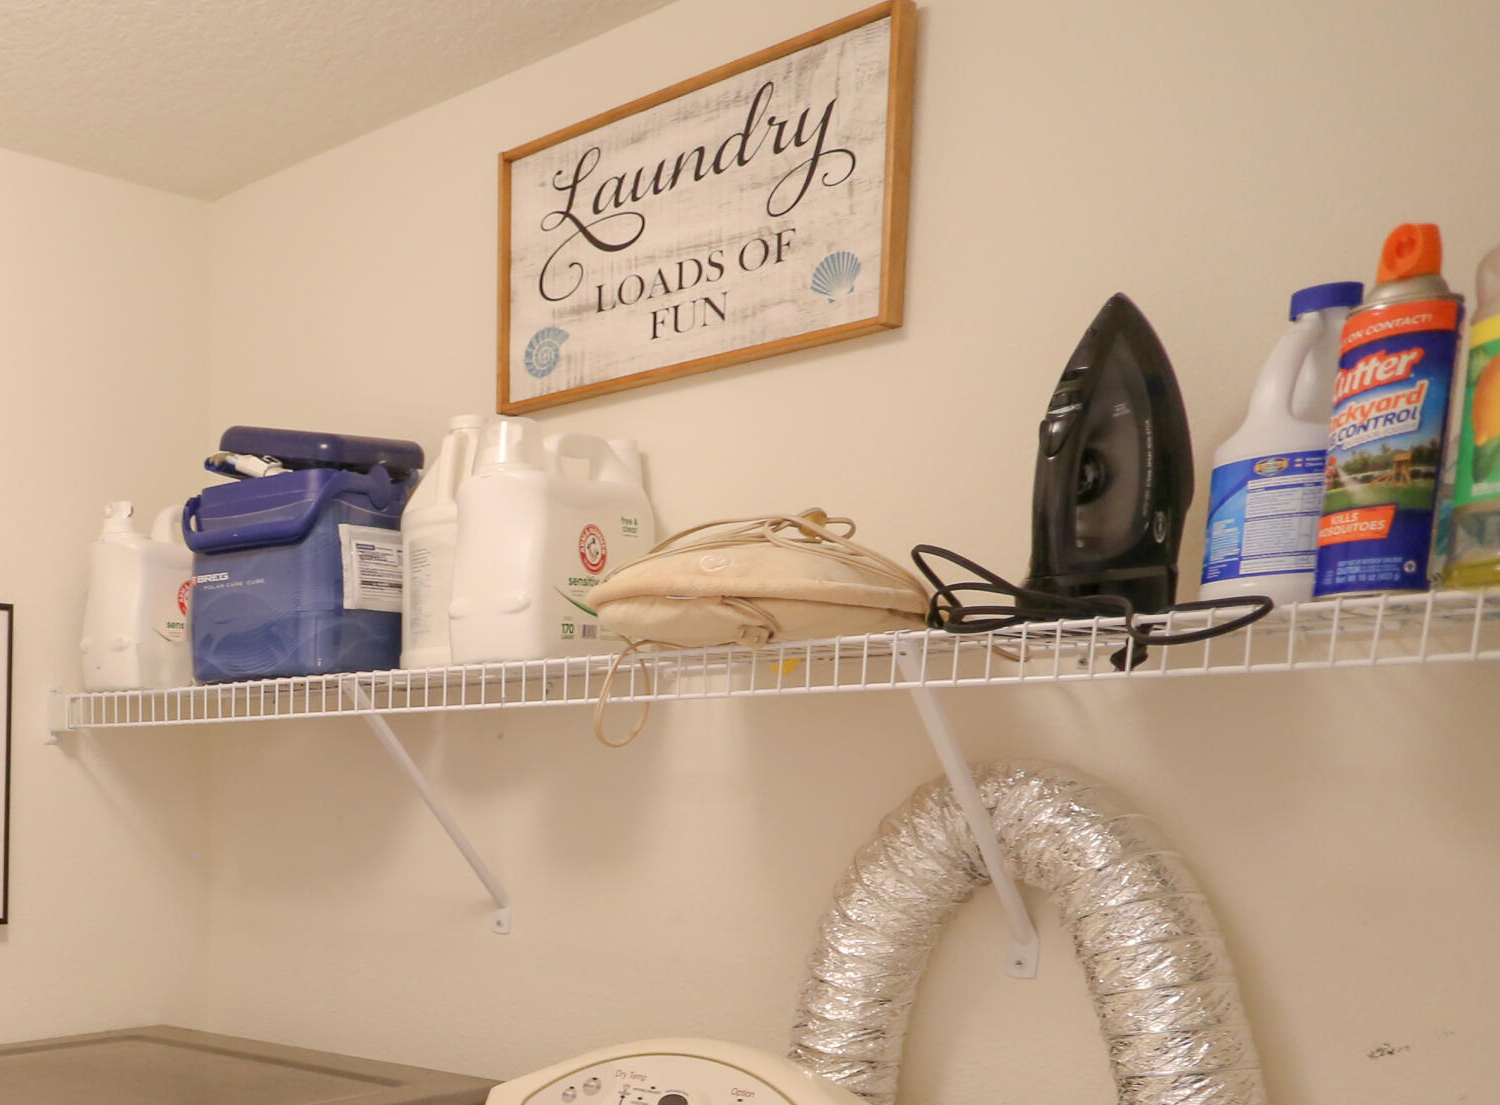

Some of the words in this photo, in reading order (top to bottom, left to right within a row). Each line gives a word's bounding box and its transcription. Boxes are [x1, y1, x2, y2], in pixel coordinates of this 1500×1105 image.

[539, 81, 857, 302] Laundry
[595, 249, 725, 314] LOADS
[737, 228, 797, 274] OF
[650, 292, 729, 341] FUN
[1338, 406, 1418, 442] CONTROL
[1331, 511, 1359, 525] KILLS
[197, 572, 229, 584] BREG
[568, 577, 601, 587] sensitiv
